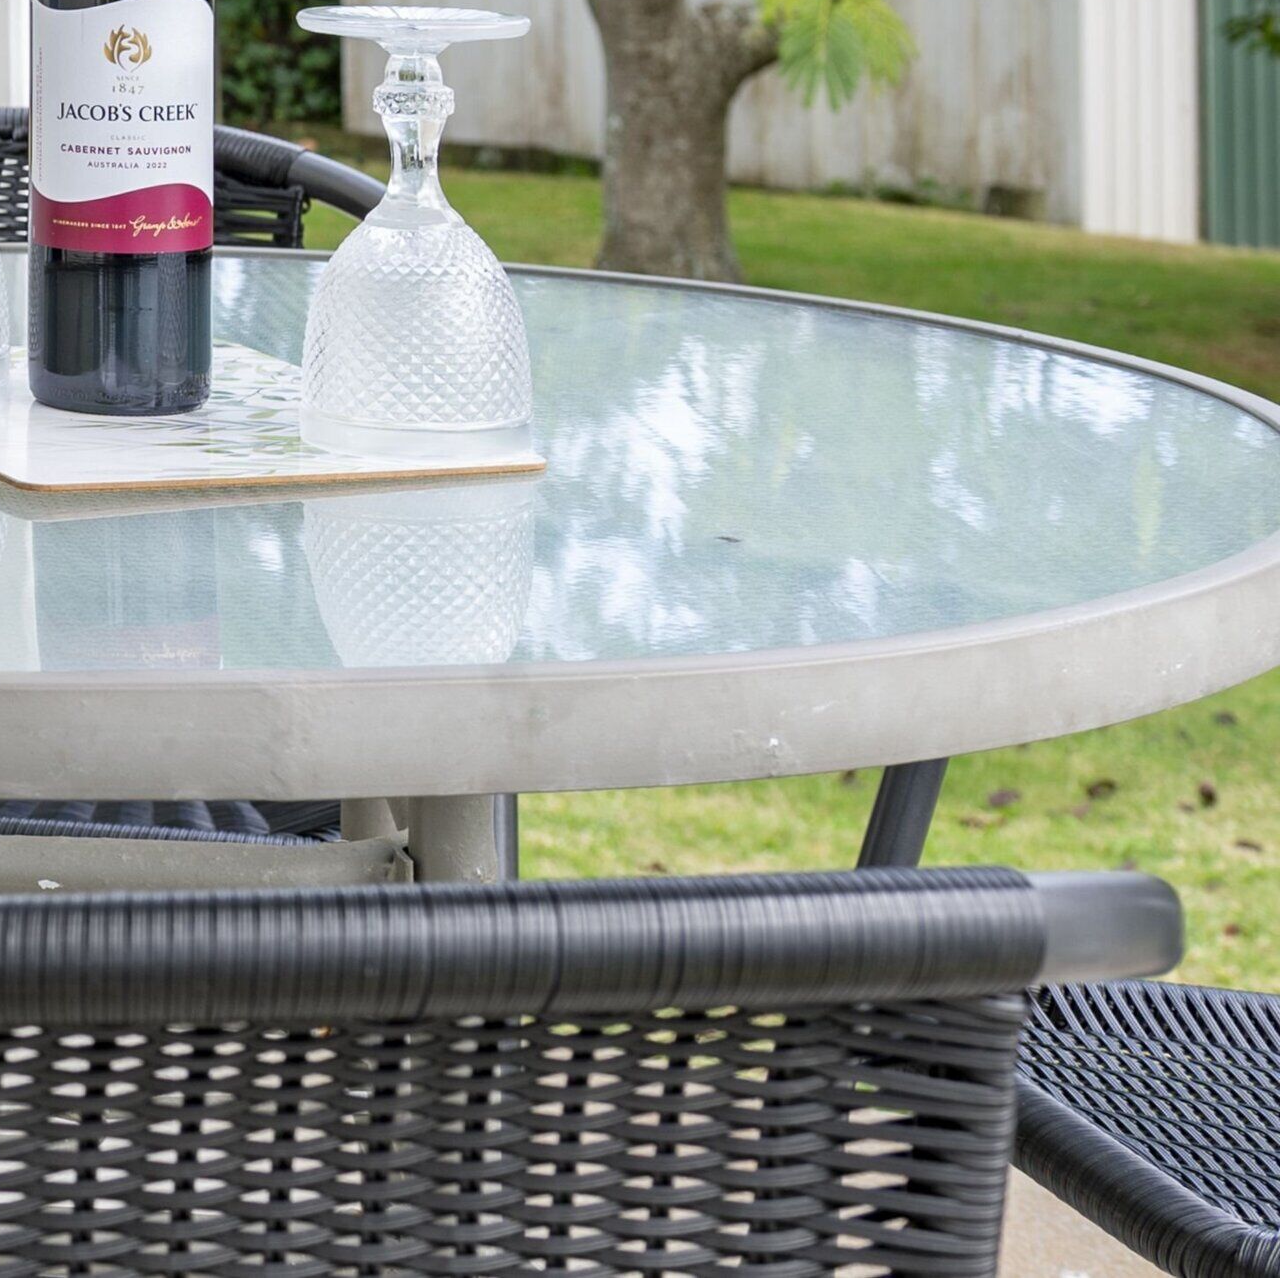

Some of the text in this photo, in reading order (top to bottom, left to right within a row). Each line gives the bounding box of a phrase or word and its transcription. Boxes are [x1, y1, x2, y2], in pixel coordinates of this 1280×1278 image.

[111, 83, 145, 95] 1847
[57, 102, 195, 123] JACOB'S CREEK
[60, 143, 192, 156] CABERNET SAUVIGNON
[87, 161, 140, 170] AUSTRALIA
